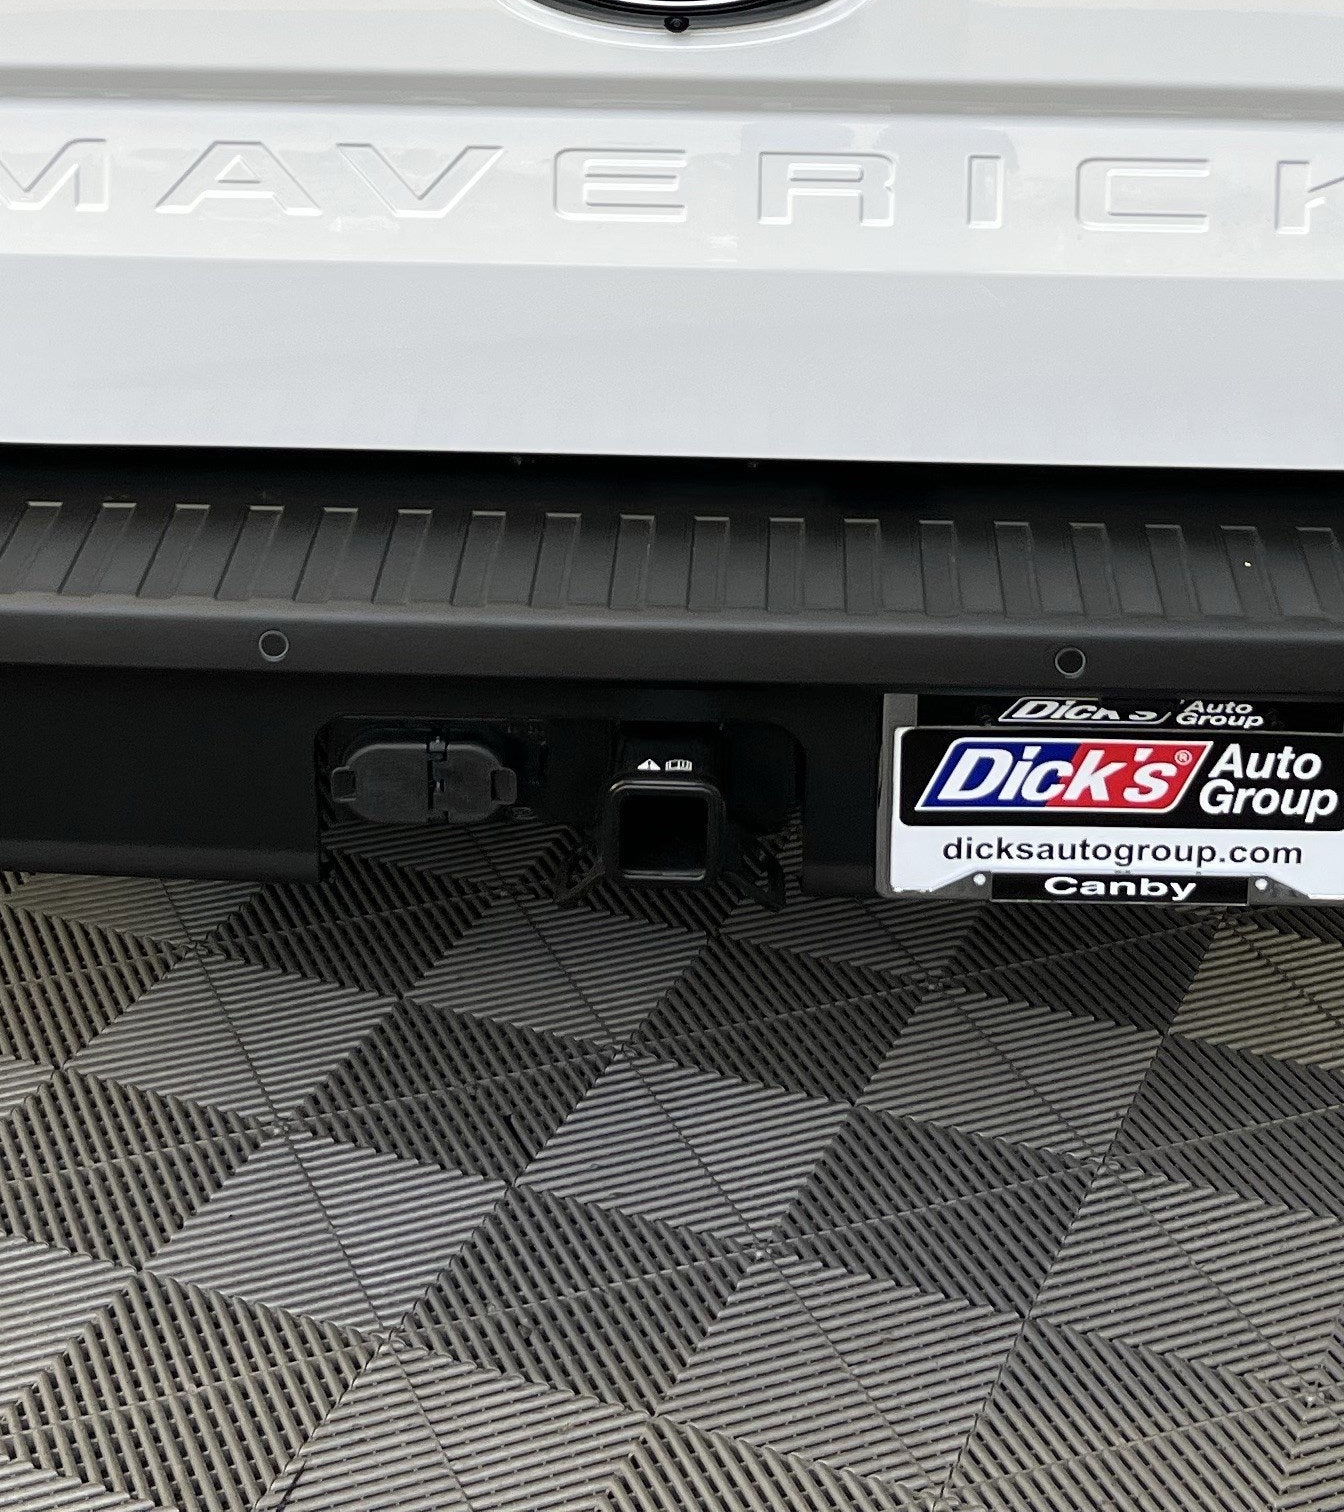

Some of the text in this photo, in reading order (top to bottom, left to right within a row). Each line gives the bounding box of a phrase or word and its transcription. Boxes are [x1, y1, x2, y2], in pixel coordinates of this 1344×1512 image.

[1175, 712, 1265, 729] Group
[1183, 700, 1253, 715] Auto
[1208, 744, 1323, 781] Auto
[1198, 778, 1340, 824] Group
[941, 836, 1304, 868] dicksautogroup.com
[1043, 876, 1198, 901] Canby
